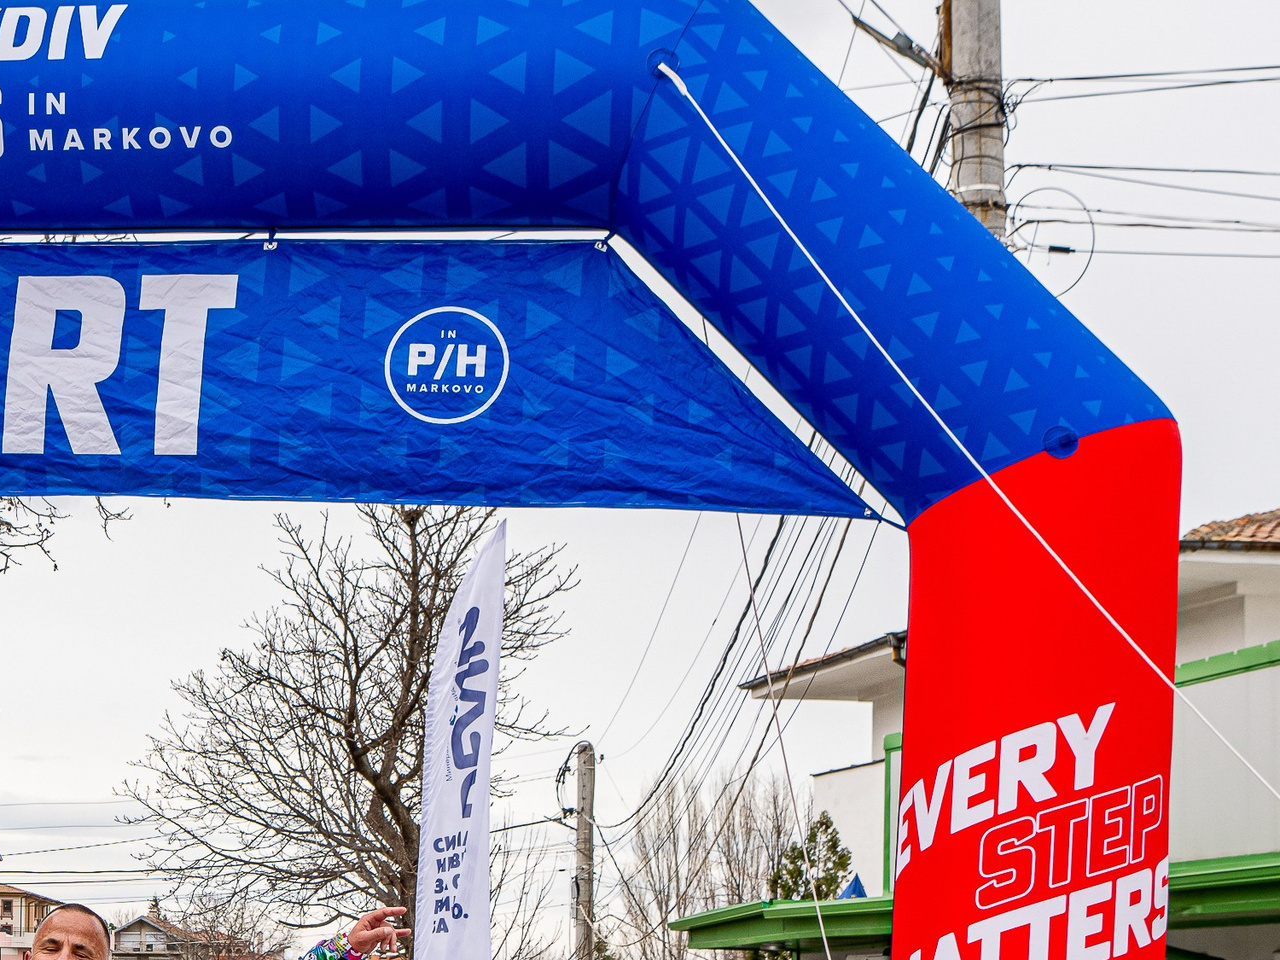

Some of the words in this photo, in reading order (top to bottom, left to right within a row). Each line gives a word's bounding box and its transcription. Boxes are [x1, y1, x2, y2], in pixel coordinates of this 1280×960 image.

[28, 92, 67, 115] IN
[29, 125, 234, 151] MARKOVO
[440, 330, 457, 339] IN
[406, 342, 487, 380] P/H
[406, 383, 484, 394] MARKOVO
[895, 702, 1116, 881] EVERY
[975, 774, 1163, 910] STEP
